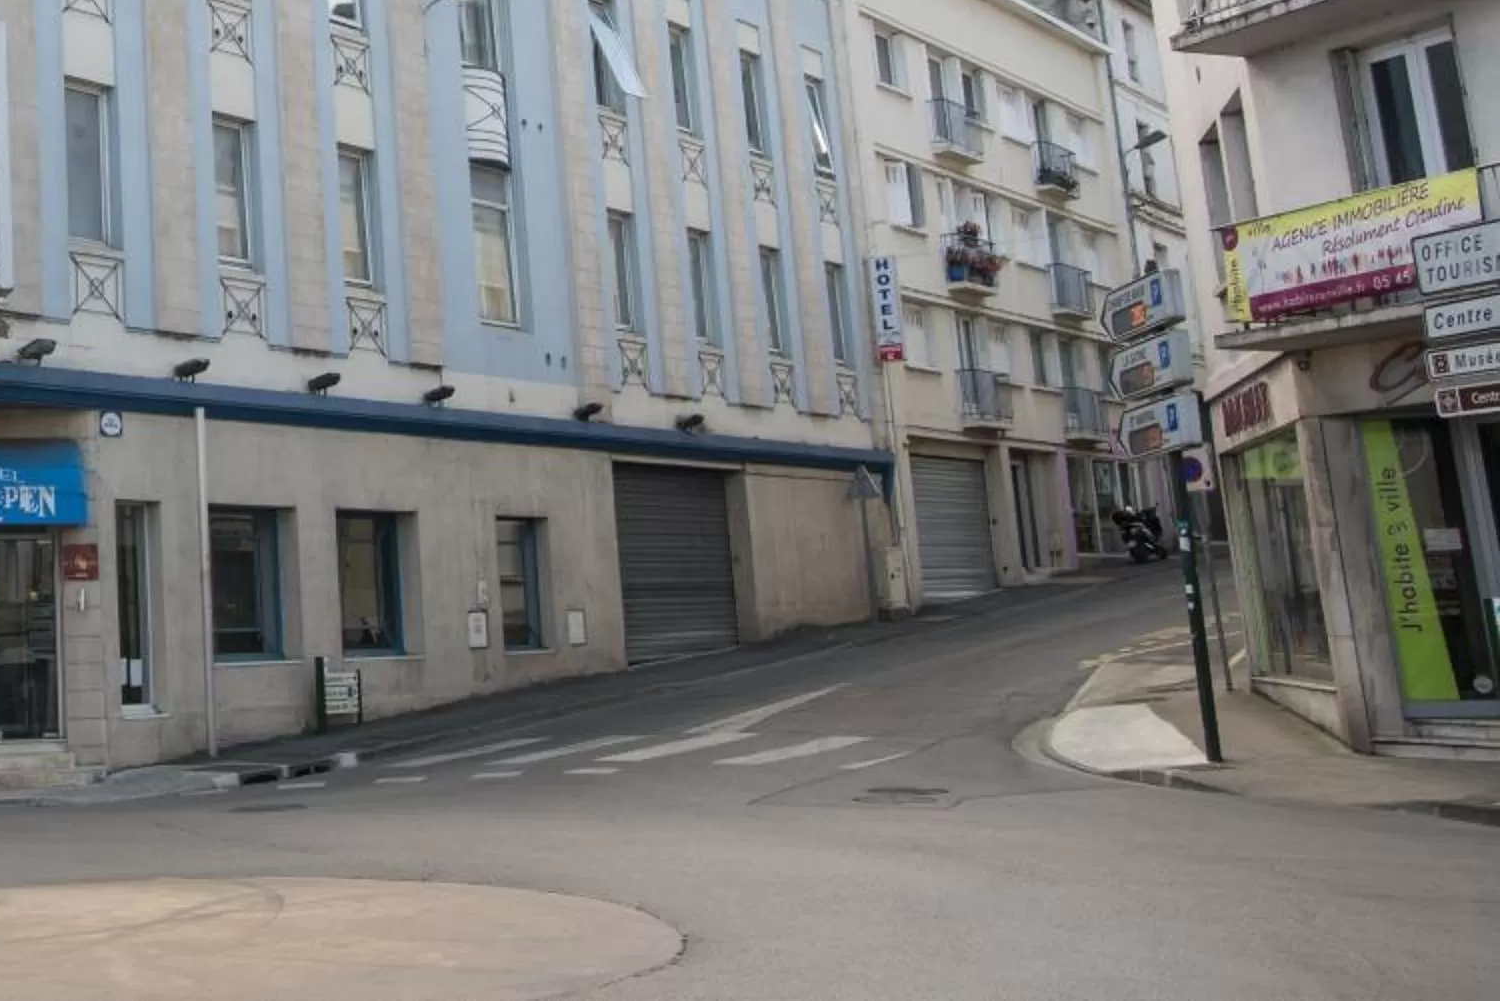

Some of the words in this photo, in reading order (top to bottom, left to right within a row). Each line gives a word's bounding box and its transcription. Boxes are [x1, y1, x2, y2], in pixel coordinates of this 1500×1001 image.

[1406, 196, 1465, 228] Citadine
[1272, 218, 1328, 251] AGENCE
[1421, 233, 1483, 262] OFFICE
[875, 259, 895, 330] HOTEL
[1433, 307, 1493, 330] Centre
[1376, 467, 1401, 512] ville
[1393, 543, 1423, 632] J'habite
